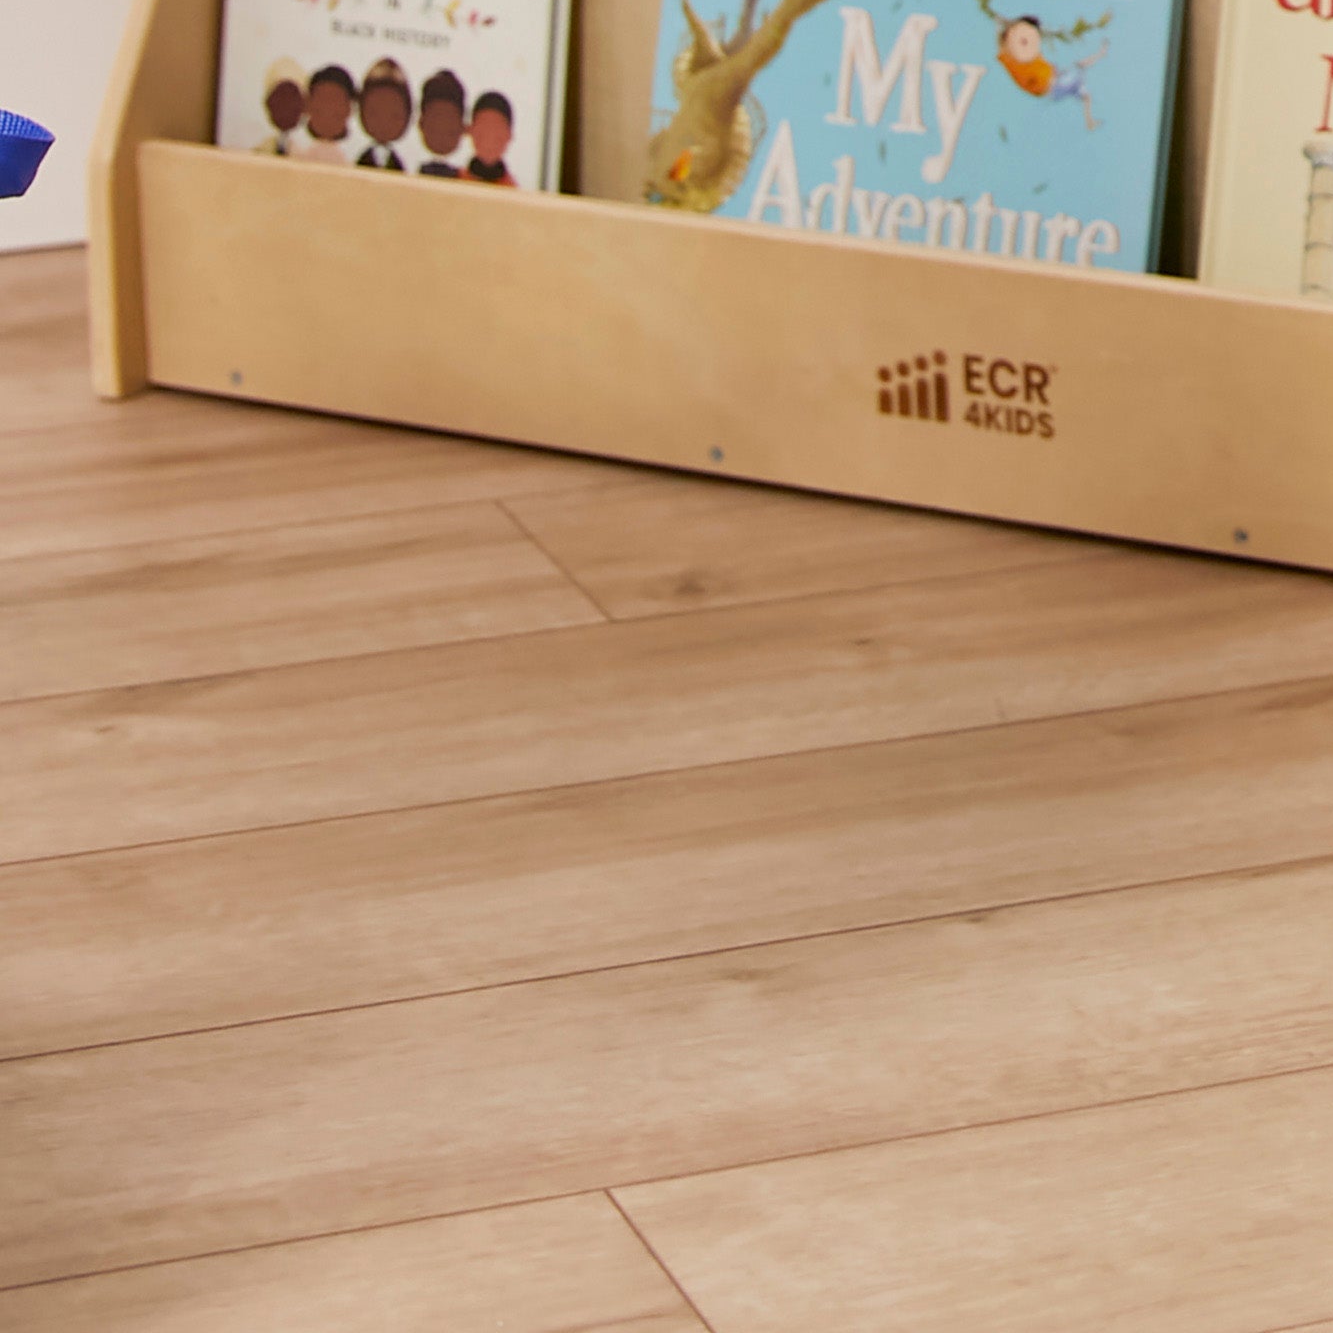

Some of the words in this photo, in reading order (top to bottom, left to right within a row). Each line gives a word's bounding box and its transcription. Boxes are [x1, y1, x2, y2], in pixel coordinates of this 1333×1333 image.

[824, 4, 987, 185] My
[746, 118, 1122, 269] Adventure
[963, 353, 1051, 406] ECR
[963, 399, 1055, 441] 4KIDS
